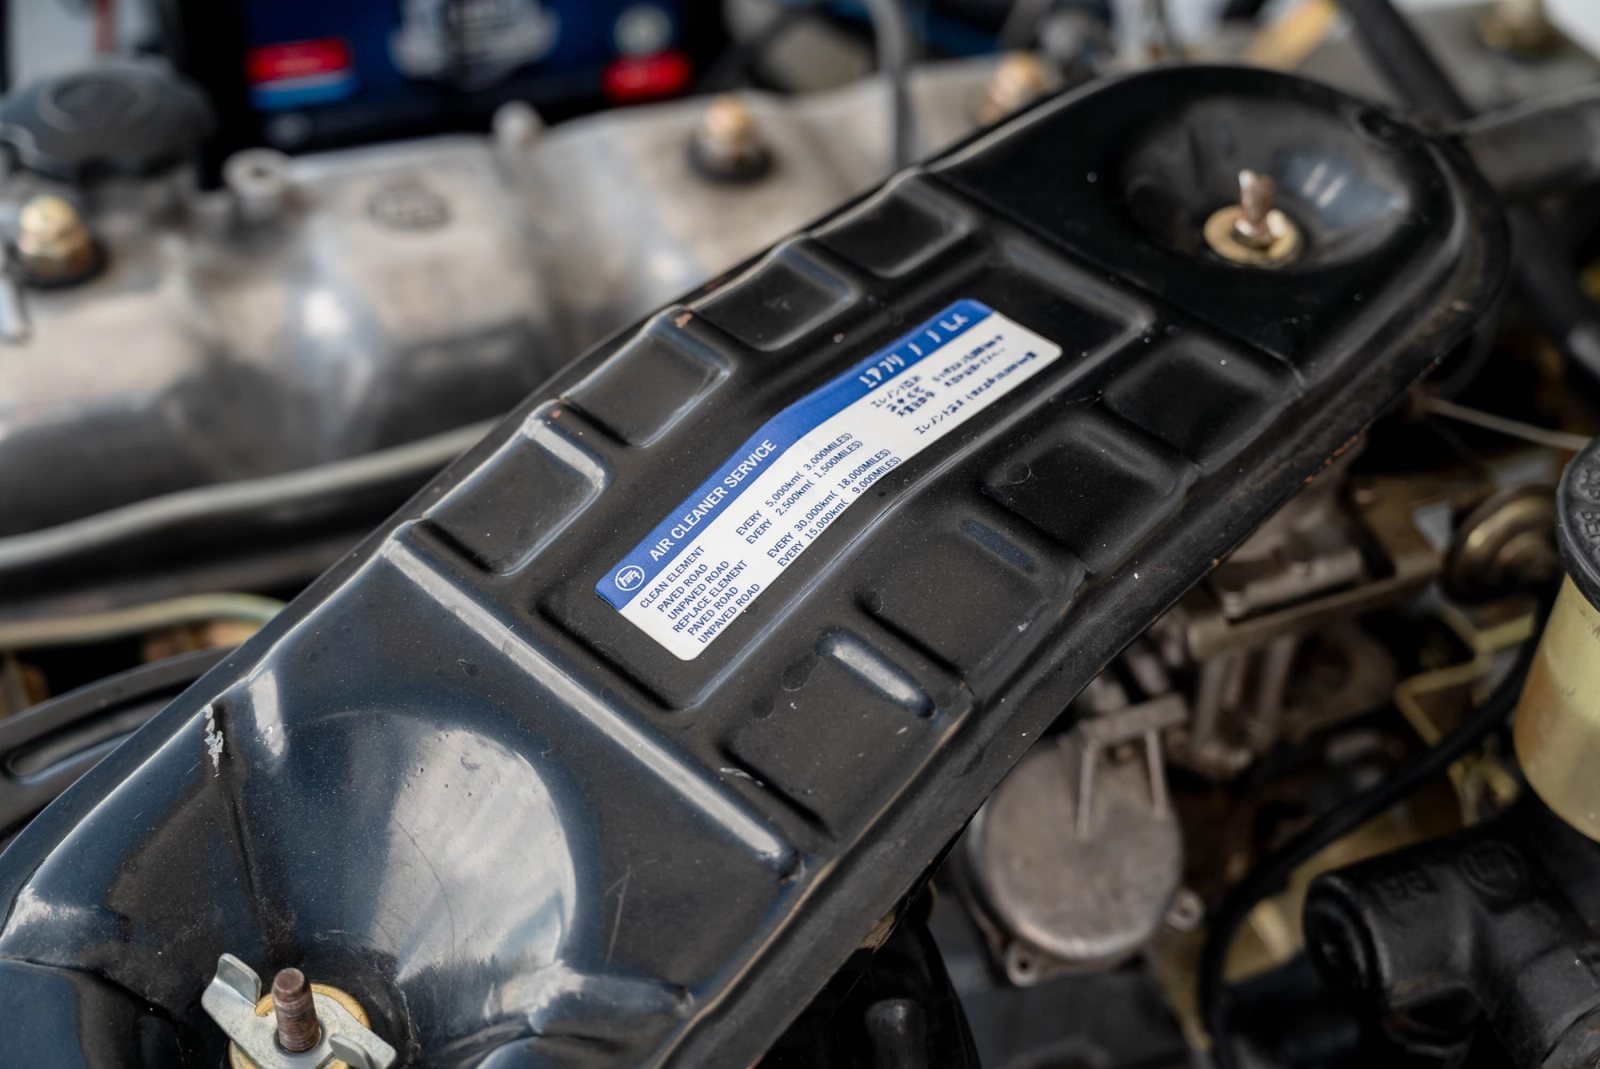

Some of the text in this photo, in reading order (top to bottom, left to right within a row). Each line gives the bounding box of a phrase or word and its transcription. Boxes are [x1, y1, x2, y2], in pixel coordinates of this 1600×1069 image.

[649, 538, 674, 561] AIR
[670, 486, 728, 538] CLEANER
[724, 439, 776, 487] SERVICE
[639, 545, 704, 607] CLEAN ELEMENT
[656, 586, 684, 612] PAVED
[683, 563, 707, 586] ROAD
[735, 510, 761, 535] EVERY
[667, 583, 706, 619] UNPAVED
[704, 560, 729, 583] ROAD
[745, 518, 772, 544] EVERY
[672, 559, 747, 632] REPLACE ELEMENT
[687, 609, 715, 635] PAVED
[713, 586, 738, 610] ROAD
[766, 531, 793, 558] EVERY
[697, 606, 736, 643] UNPAVED
[735, 583, 759, 606] ROAD
[777, 540, 804, 566] EVERY
